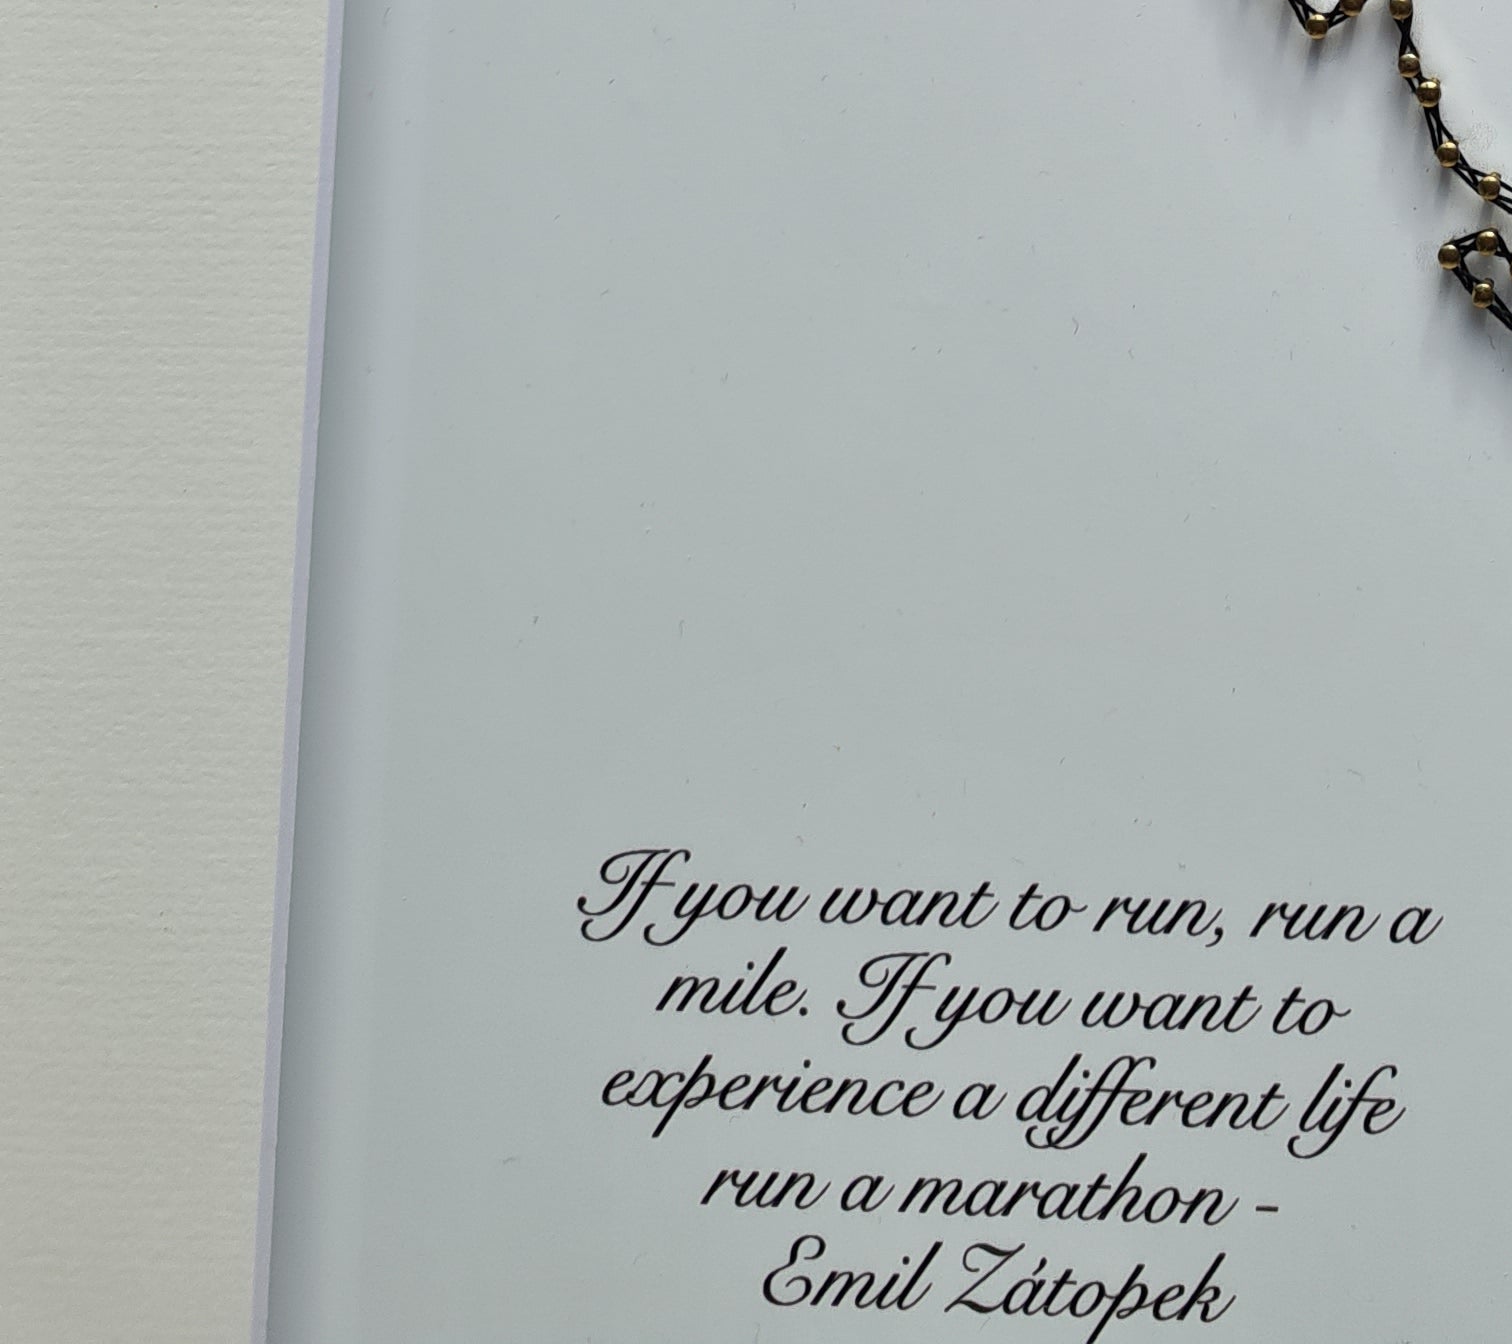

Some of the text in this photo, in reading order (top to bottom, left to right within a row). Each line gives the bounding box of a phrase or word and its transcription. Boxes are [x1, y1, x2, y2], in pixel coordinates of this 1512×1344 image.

[577, 849, 1444, 948] If you want to run, run a
[655, 946, 1352, 1051] mile. If you want to
[601, 1054, 1406, 1160] experience a different life
[700, 1169, 831, 1210] run
[840, 1174, 895, 1213] a
[898, 1152, 1240, 1226] marathon
[762, 1234, 1237, 1344] Emil Zátopek
